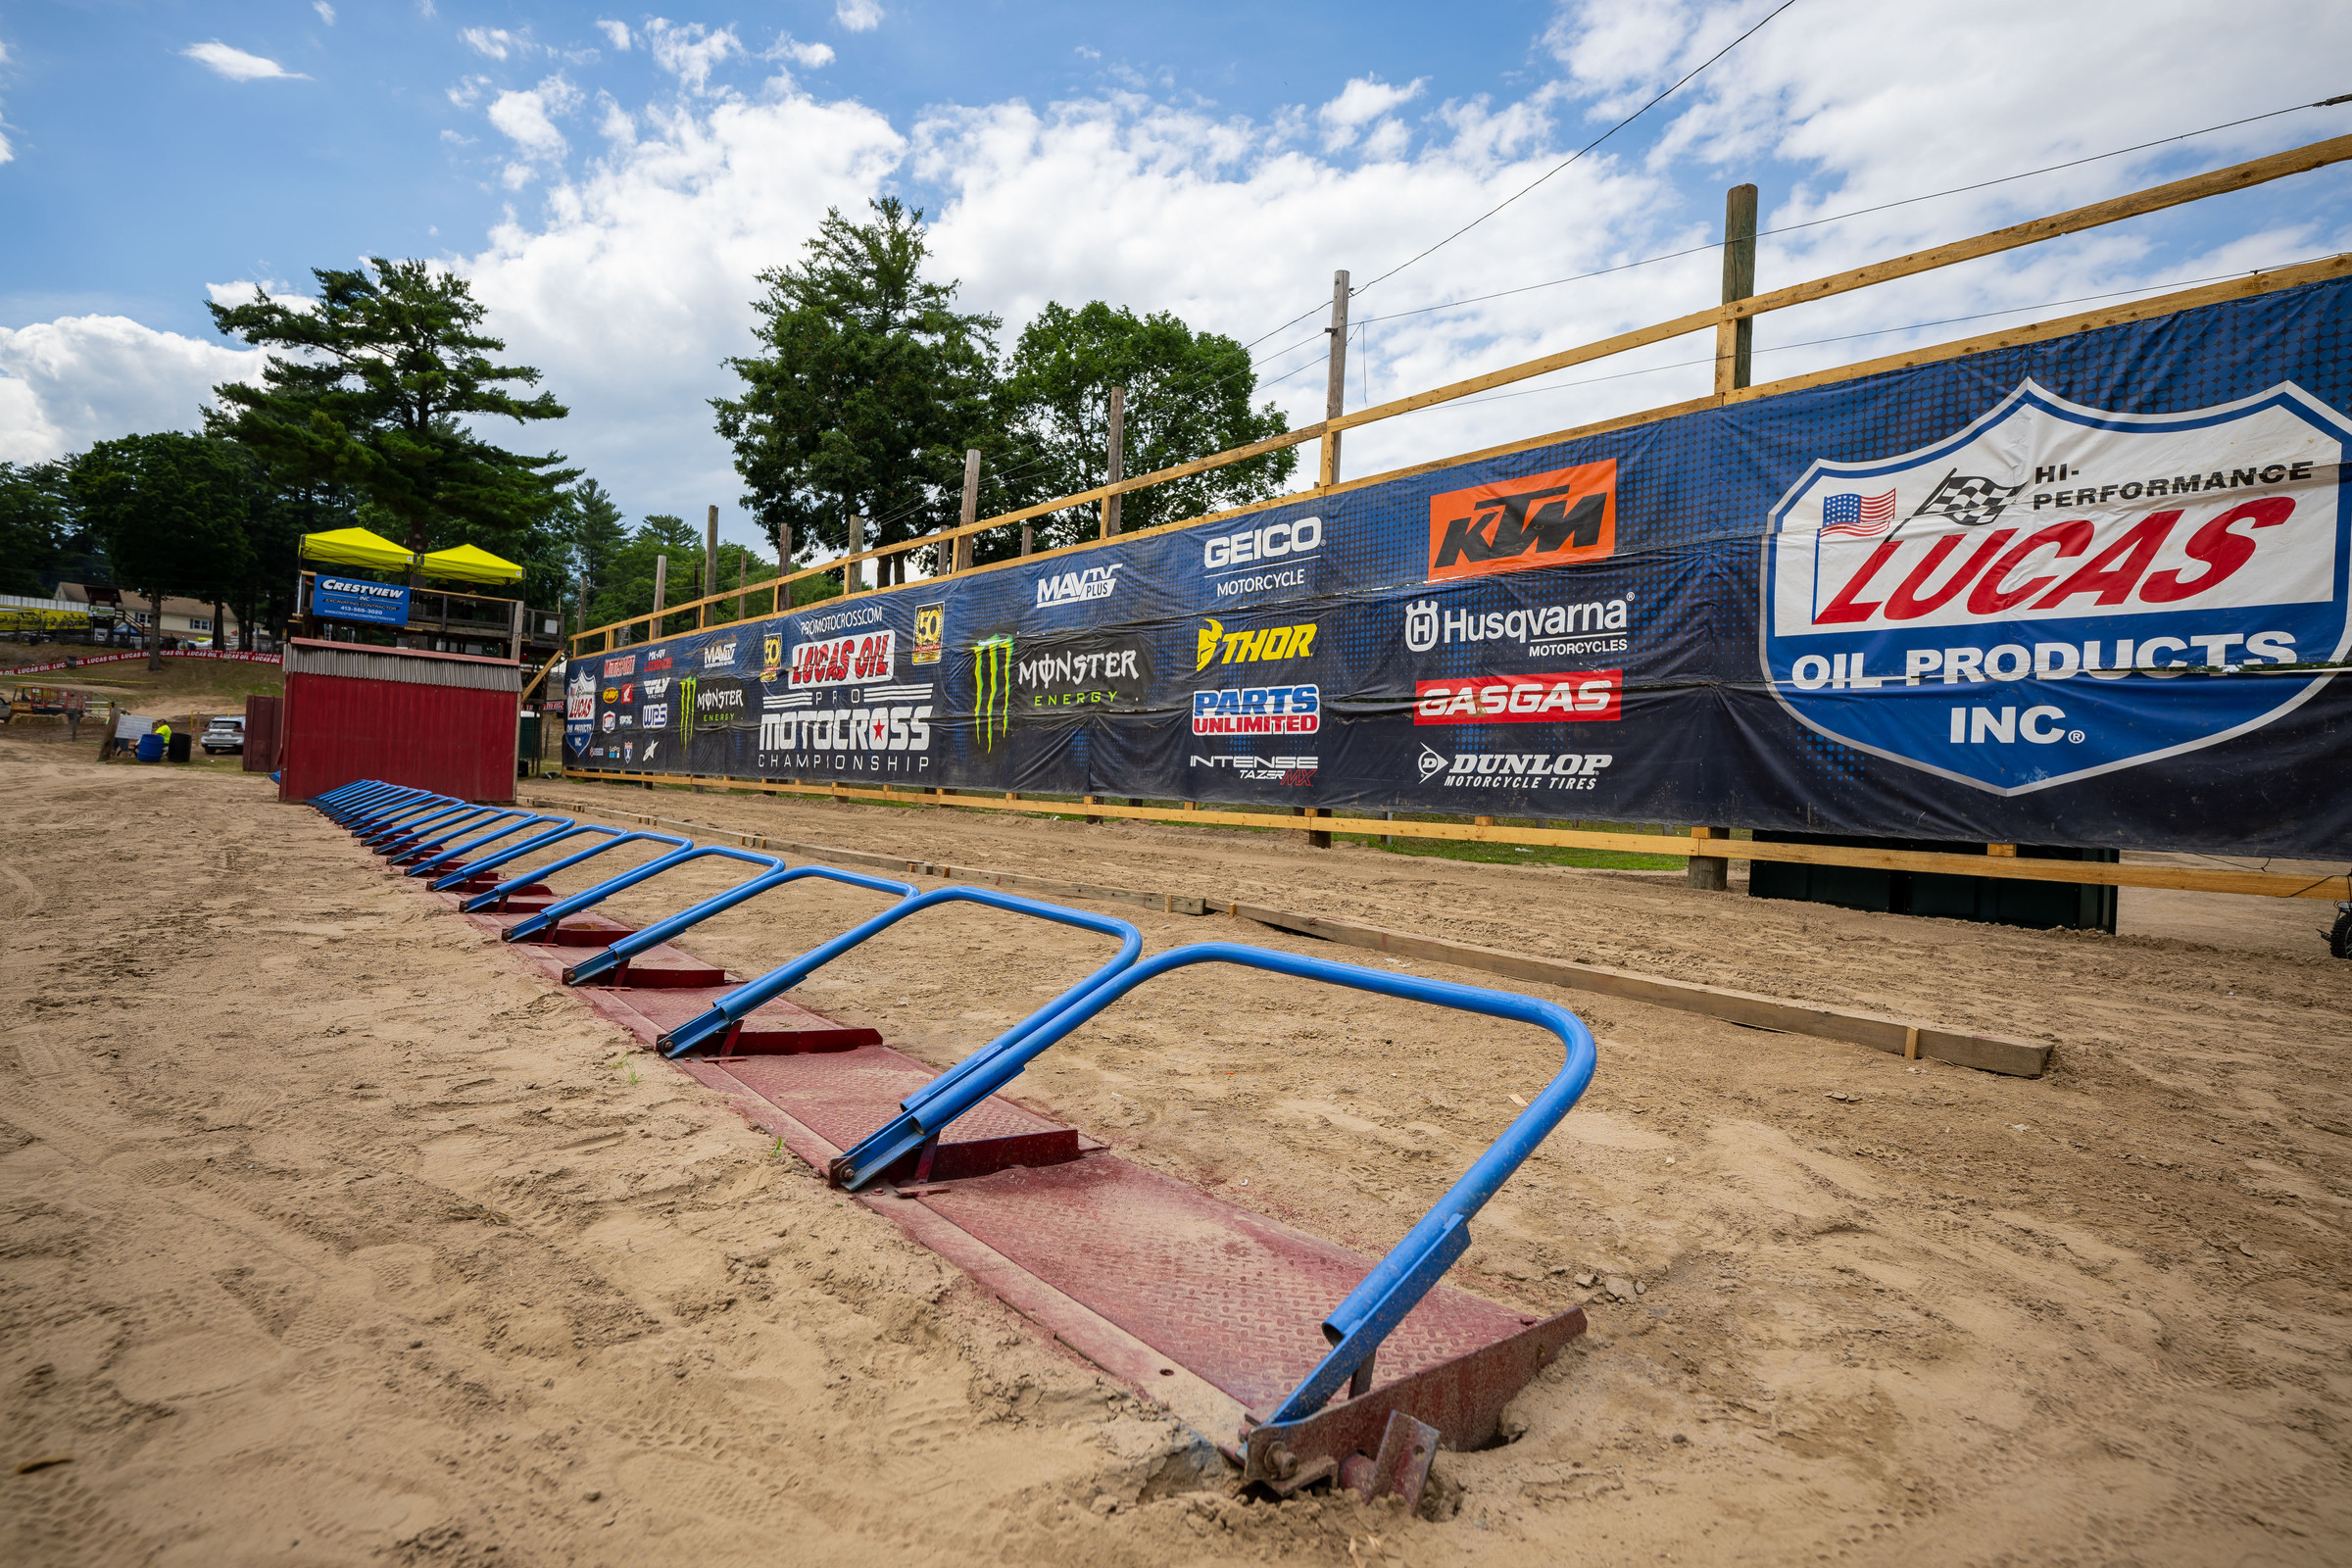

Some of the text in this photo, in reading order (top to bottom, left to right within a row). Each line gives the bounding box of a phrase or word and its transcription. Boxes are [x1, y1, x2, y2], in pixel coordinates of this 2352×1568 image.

[2033, 460, 2314, 511] PERFORMANCE
[2034, 463, 2080, 485] HI-
[1434, 484, 1608, 569] KTM
[1204, 516, 1322, 568] GEICO
[1812, 496, 2297, 625] LUCAS
[321, 578, 404, 599] CRESTVIEW
[1086, 581, 1108, 598] PLUS
[1217, 568, 1305, 598] MOTORCYCLE
[325, 598, 397, 611] EXCAVATING CONTRACTOR
[340, 606, 383, 615] 413-569-3020
[800, 607, 883, 635] PROMOTOCROSS.COM
[918, 609, 941, 643] 50
[1444, 599, 1628, 644] Husqvarna
[764, 638, 780, 664] 50
[1221, 623, 1318, 664] THOR
[1529, 639, 1628, 658] MOTORCYCLES
[792, 634, 890, 684] LUCAS OIL
[1018, 649, 1139, 689] MONSTER
[1790, 630, 2298, 691] OIL PRODUCTS
[568, 698, 593, 718] LUCAS
[697, 688, 744, 711] MONSTER
[816, 689, 860, 705] PRO
[1034, 691, 1117, 707] ENERGY
[1195, 686, 1318, 716] PARTS
[1419, 680, 1612, 716] GASGAS
[643, 703, 667, 728] WPS
[704, 713, 735, 722] ENERGY
[1193, 714, 1318, 733] UNLIMITED
[760, 706, 933, 751] MOTOCROSS
[758, 754, 929, 773] CHAMPIONSHIP
[1190, 755, 1319, 769] INTENSE
[1448, 754, 1613, 775] DUNLOP
[1240, 769, 1317, 786] TAZER MX
[1444, 775, 1597, 790] MOTORCYCLE TIRES
